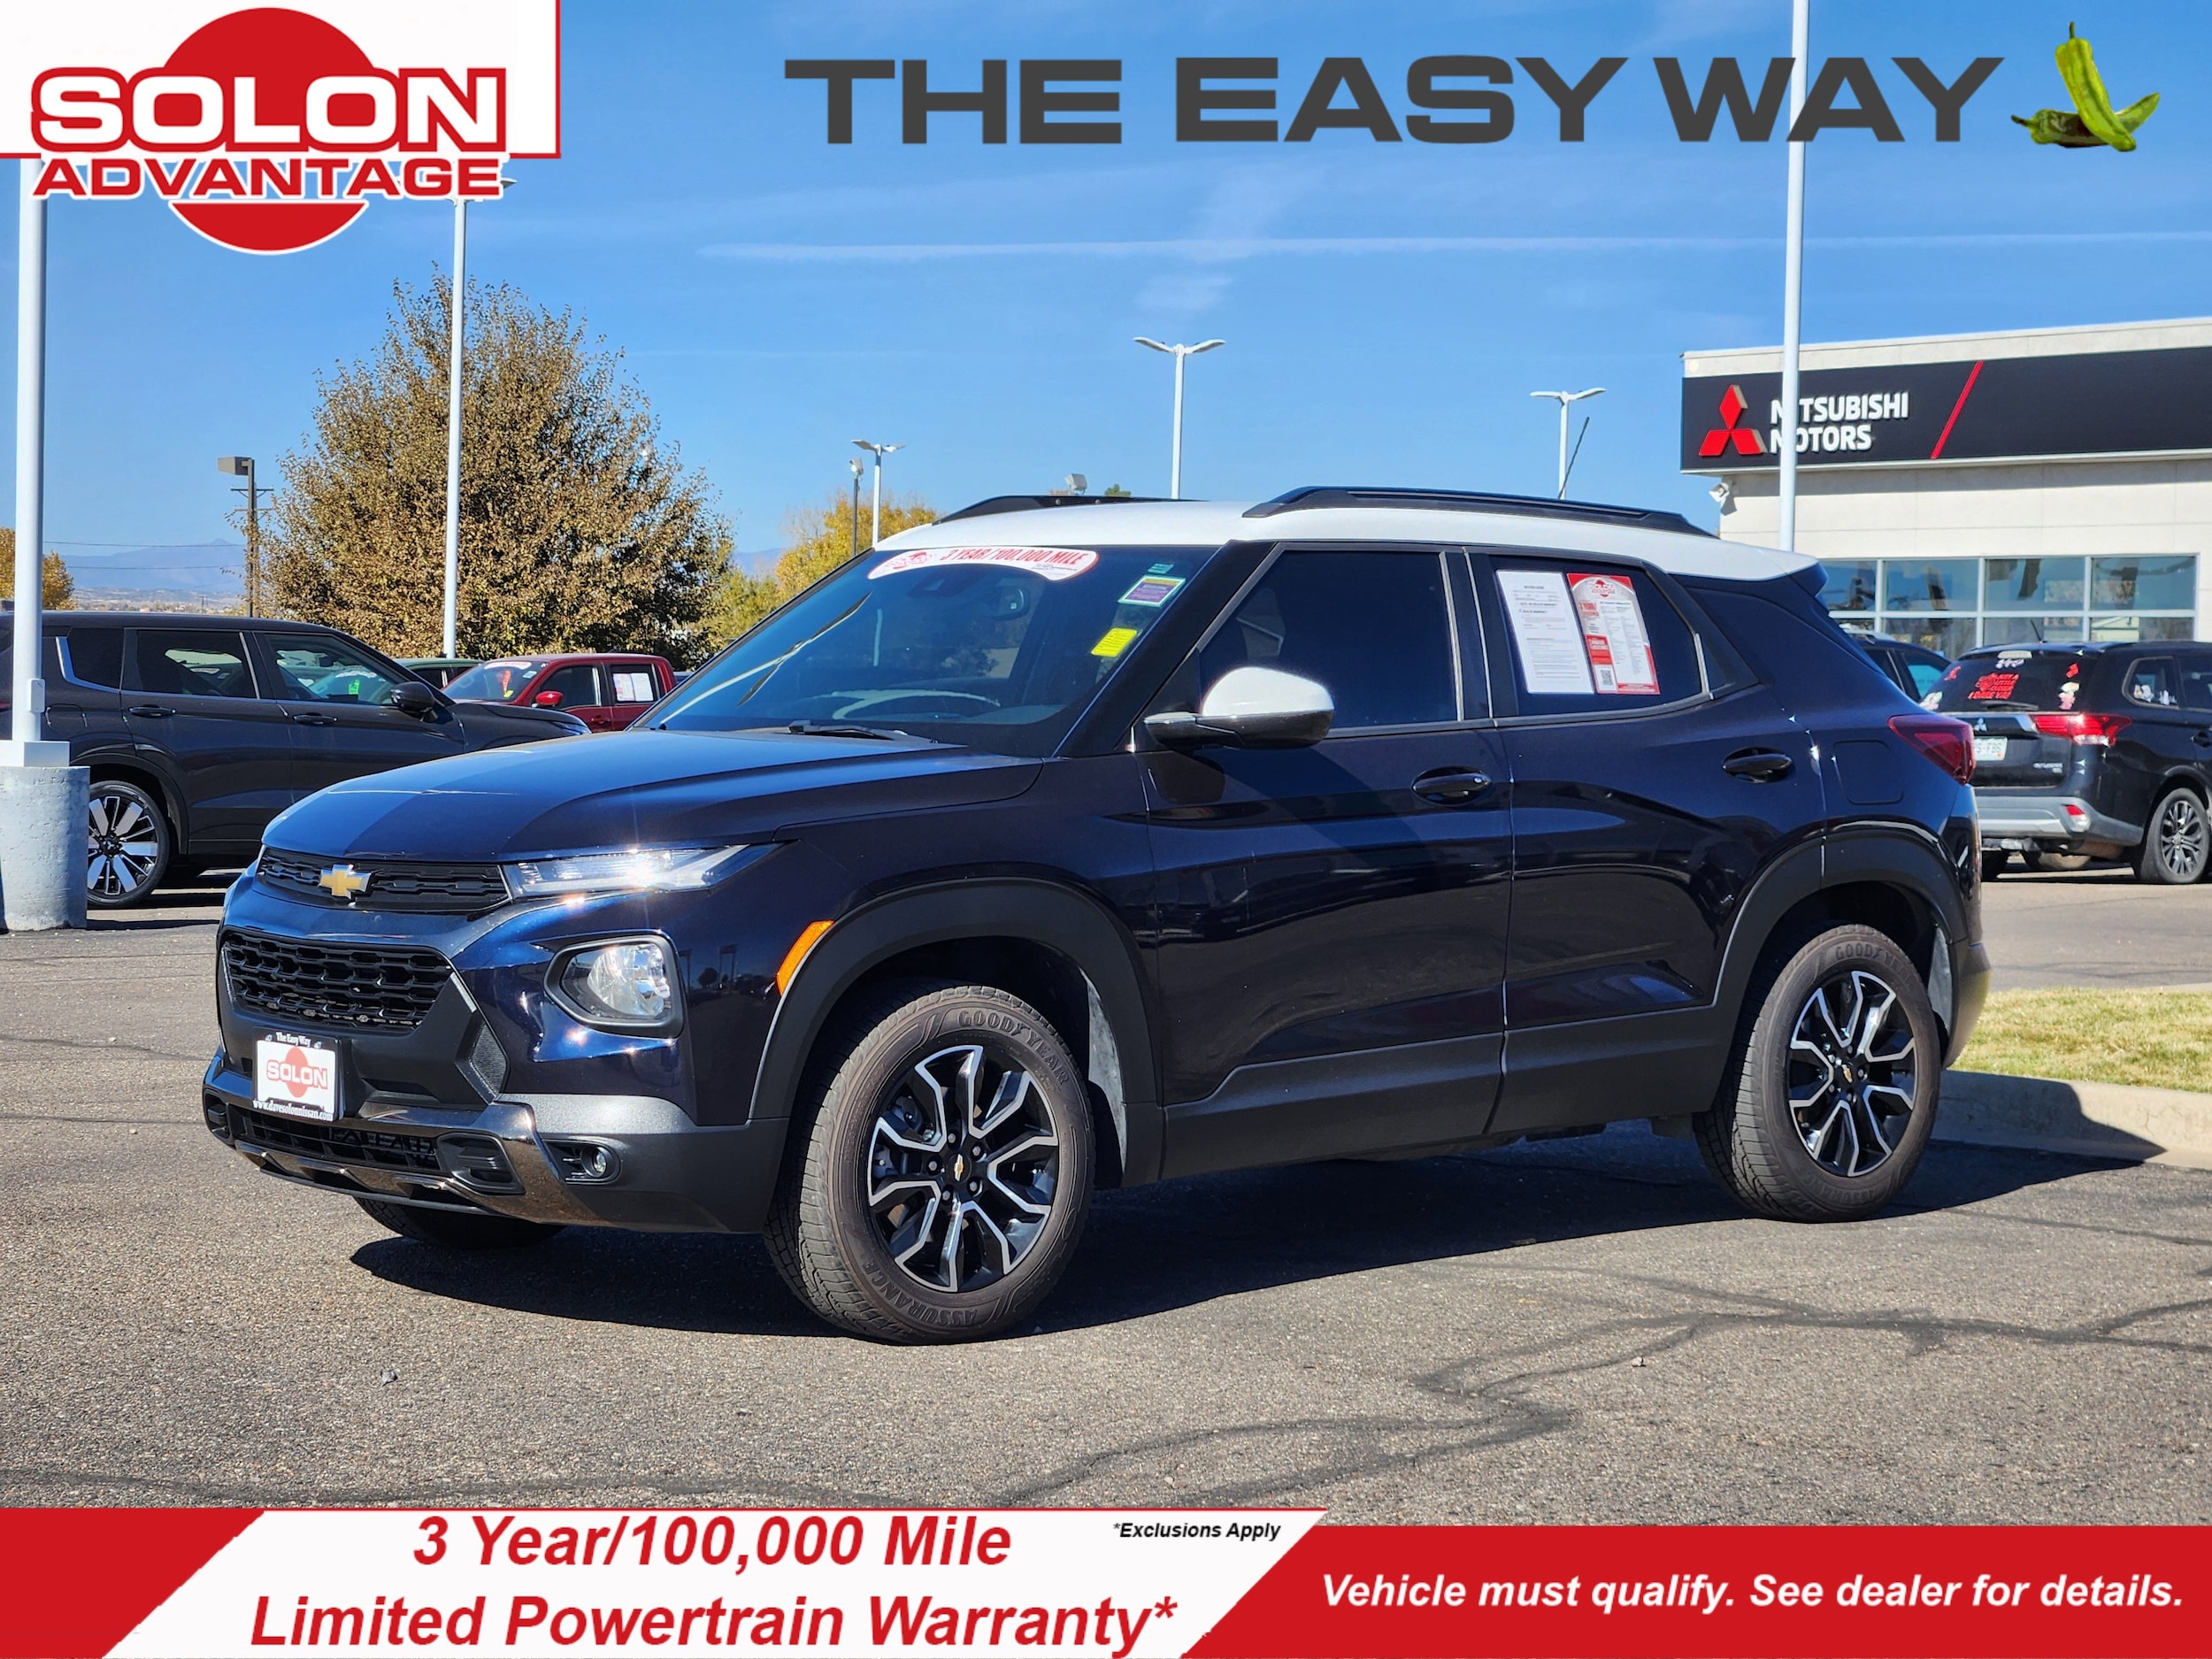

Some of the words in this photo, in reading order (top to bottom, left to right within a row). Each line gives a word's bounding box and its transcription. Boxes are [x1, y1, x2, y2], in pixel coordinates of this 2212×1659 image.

[1770, 390, 1909, 425] MTSUBISHI
[939, 548, 959, 561] 3
[1044, 551, 1090, 565] MILE
[275, 1032, 287, 1042] The
[287, 1033, 299, 1047] Easy
[298, 1035, 311, 1048] Way
[957, 1010, 1071, 1086] GOODYEAR
[267, 1060, 327, 1089] SOLON
[252, 1101, 333, 1121] www.davesolonnissan.com
[861, 1258, 978, 1326] ASSURANCE
